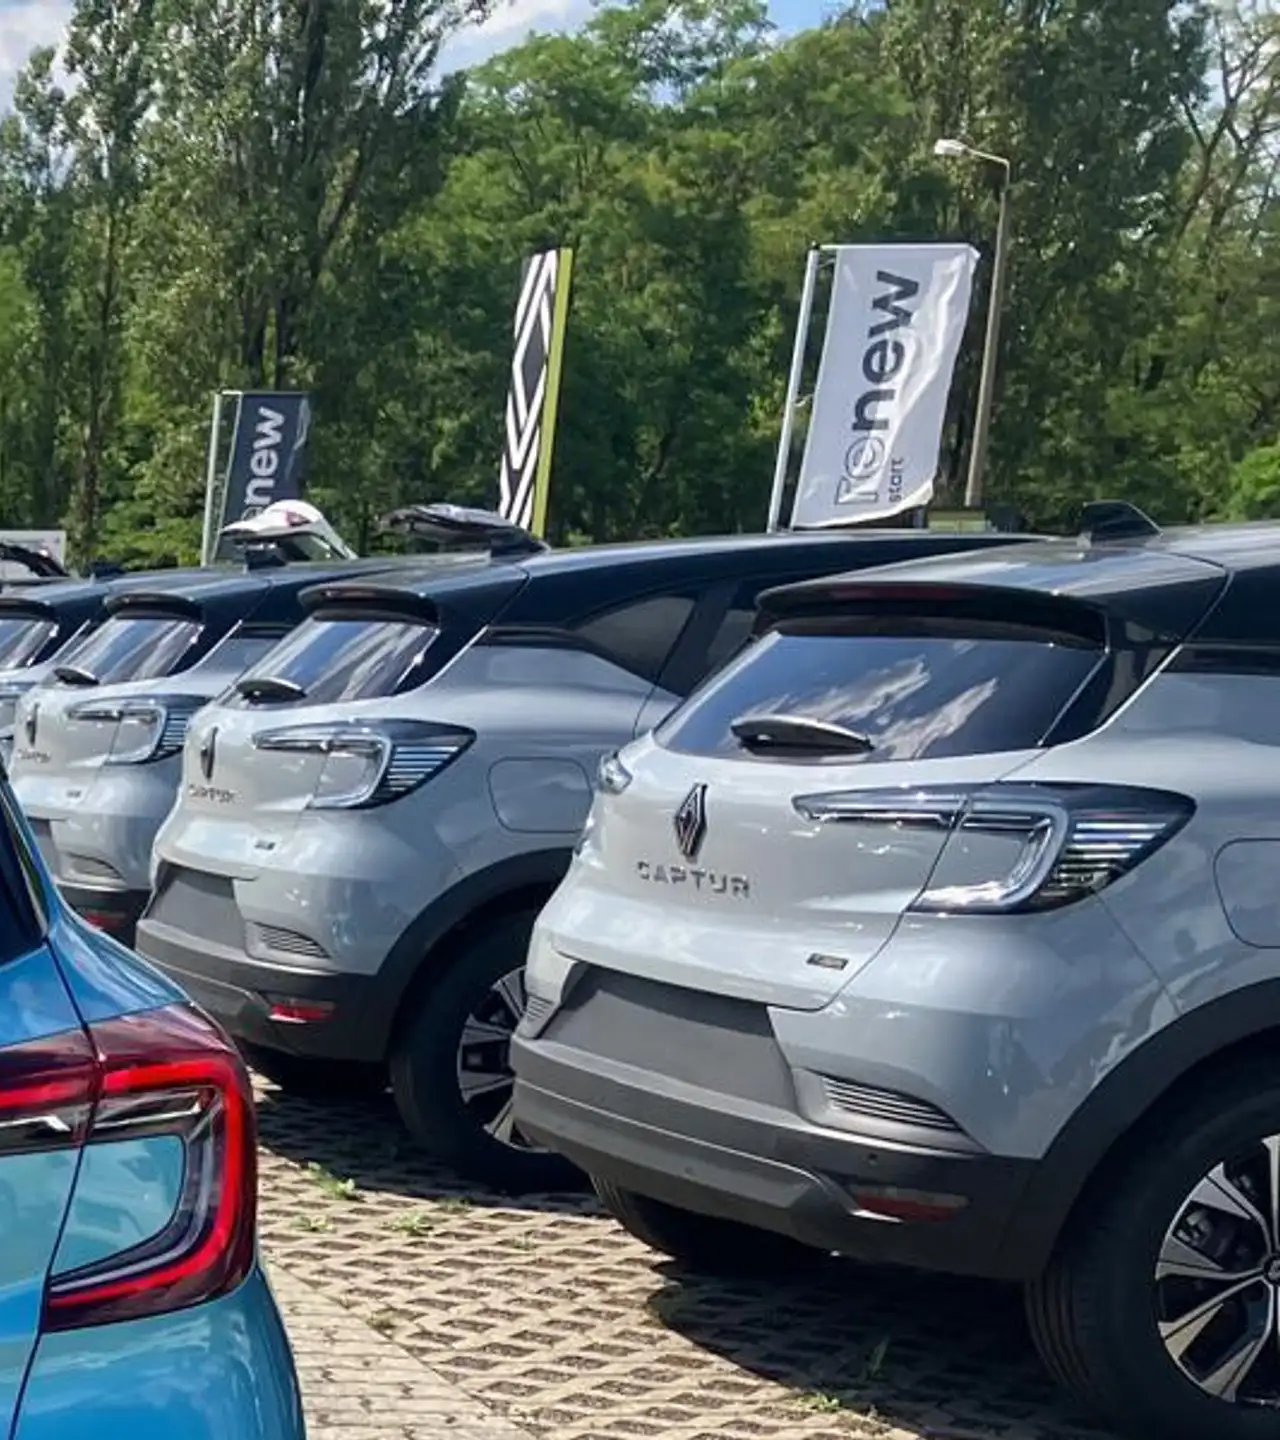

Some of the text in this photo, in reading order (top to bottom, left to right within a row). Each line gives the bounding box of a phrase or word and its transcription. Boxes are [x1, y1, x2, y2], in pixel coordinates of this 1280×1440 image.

[834, 269, 920, 506] renew
[242, 406, 286, 521] new
[636, 860, 750, 898] CAPTUR
